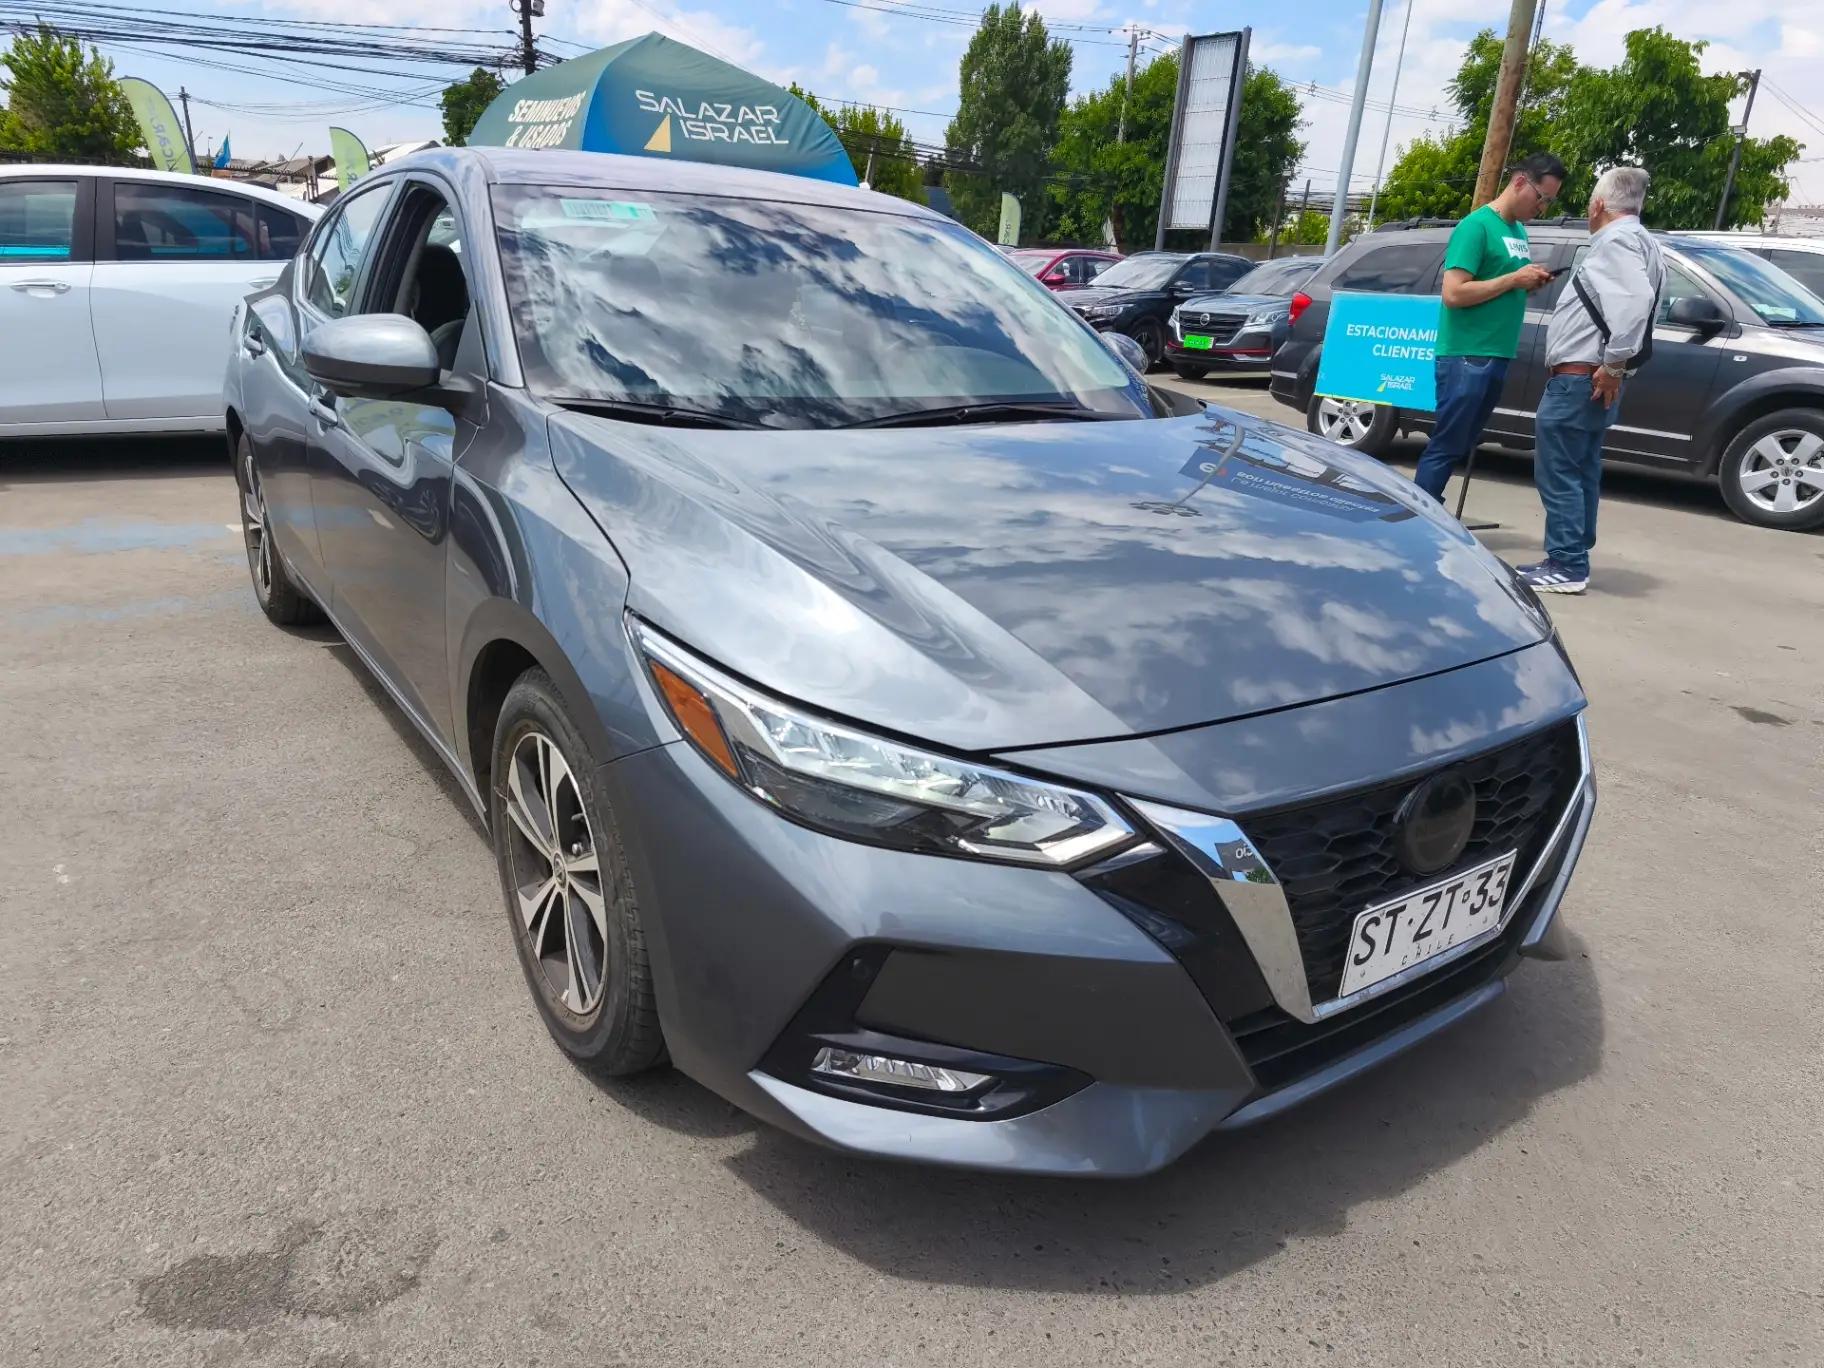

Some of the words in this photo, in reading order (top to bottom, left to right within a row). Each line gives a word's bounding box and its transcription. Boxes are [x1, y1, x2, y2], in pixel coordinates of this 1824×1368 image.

[507, 90, 586, 122] SEMINUEVOS
[635, 89, 781, 124] SALAZAR
[518, 119, 573, 148] USADOS
[680, 119, 789, 145] ISRAEL
[1372, 343, 1435, 361] CLIENTES
[1380, 373, 1416, 384] SALAZAR
[1387, 380, 1415, 391] ISRAEL
[1401, 933, 1455, 965] CHILE
